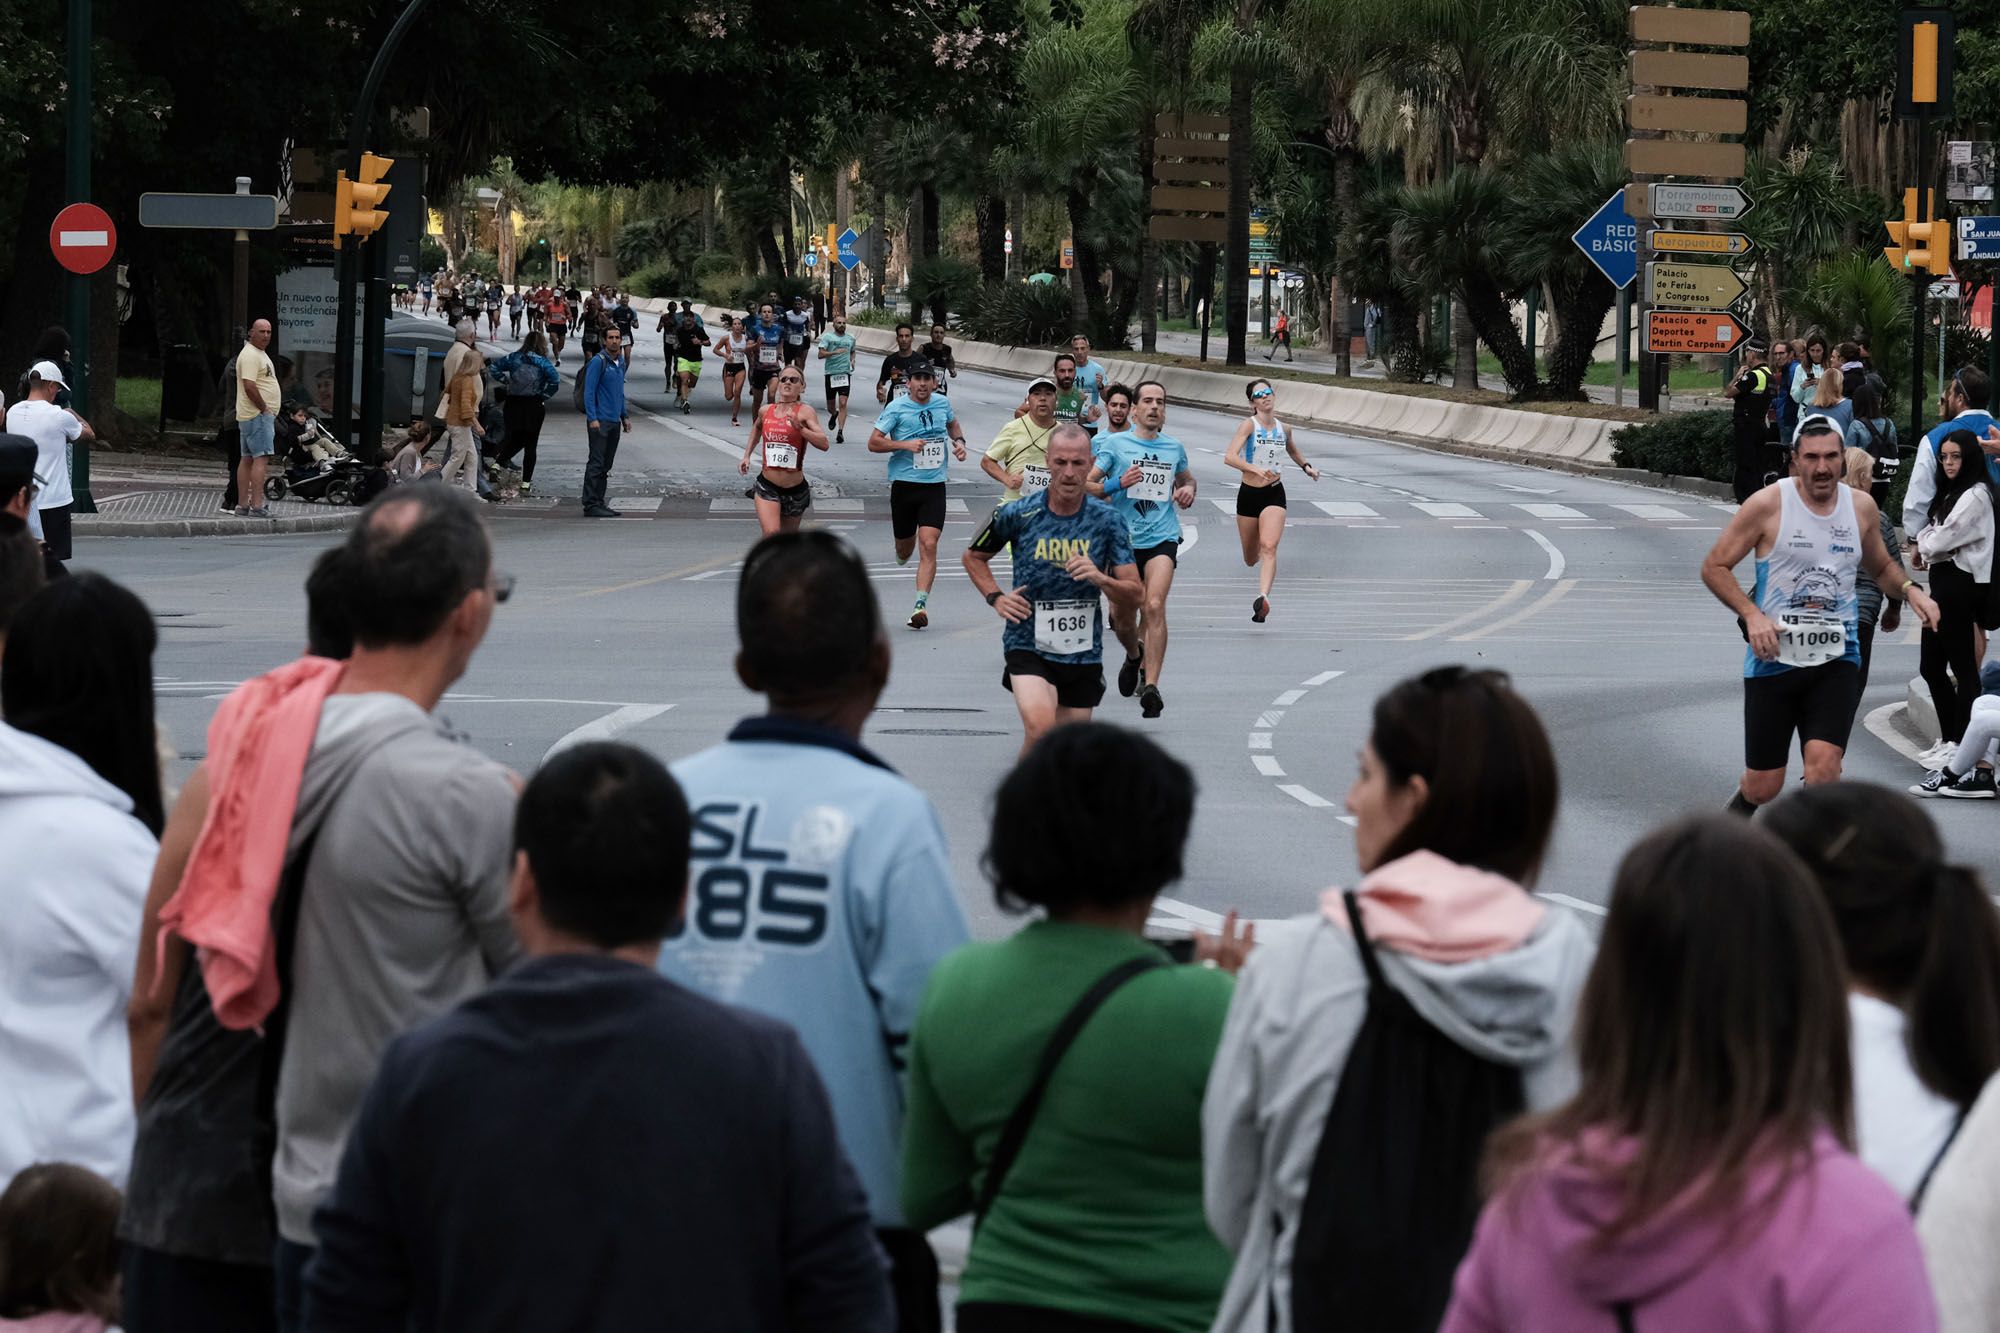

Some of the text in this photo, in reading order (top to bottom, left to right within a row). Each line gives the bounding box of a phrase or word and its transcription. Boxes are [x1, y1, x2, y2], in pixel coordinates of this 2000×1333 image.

[1658, 189, 1736, 201] Torremolinos
[1606, 225, 1636, 237] RED
[1961, 218, 1976, 238] P
[1592, 237, 1637, 252] BÁSIC
[1657, 236, 1723, 249] Aeropuerto
[1963, 240, 1977, 260] P
[1656, 268, 1688, 278] Palacio
[1670, 281, 1697, 290] Ferias
[293, 294, 321, 303] nuevo
[1665, 292, 1710, 302] Congresos
[1652, 315, 1708, 325] Palacio de
[1652, 327, 1695, 337] Deportes
[1687, 339, 1726, 349] Carpena
[921, 446, 941, 457] 1152
[1269, 450, 1274, 458] 5
[772, 454, 789, 463] 186
[1034, 538, 1091, 561] ARMY
[1048, 615, 1087, 632] 1636
[1782, 614, 1799, 625] 43
[1784, 631, 1841, 647] 11006
[664, 866, 829, 948] 85
